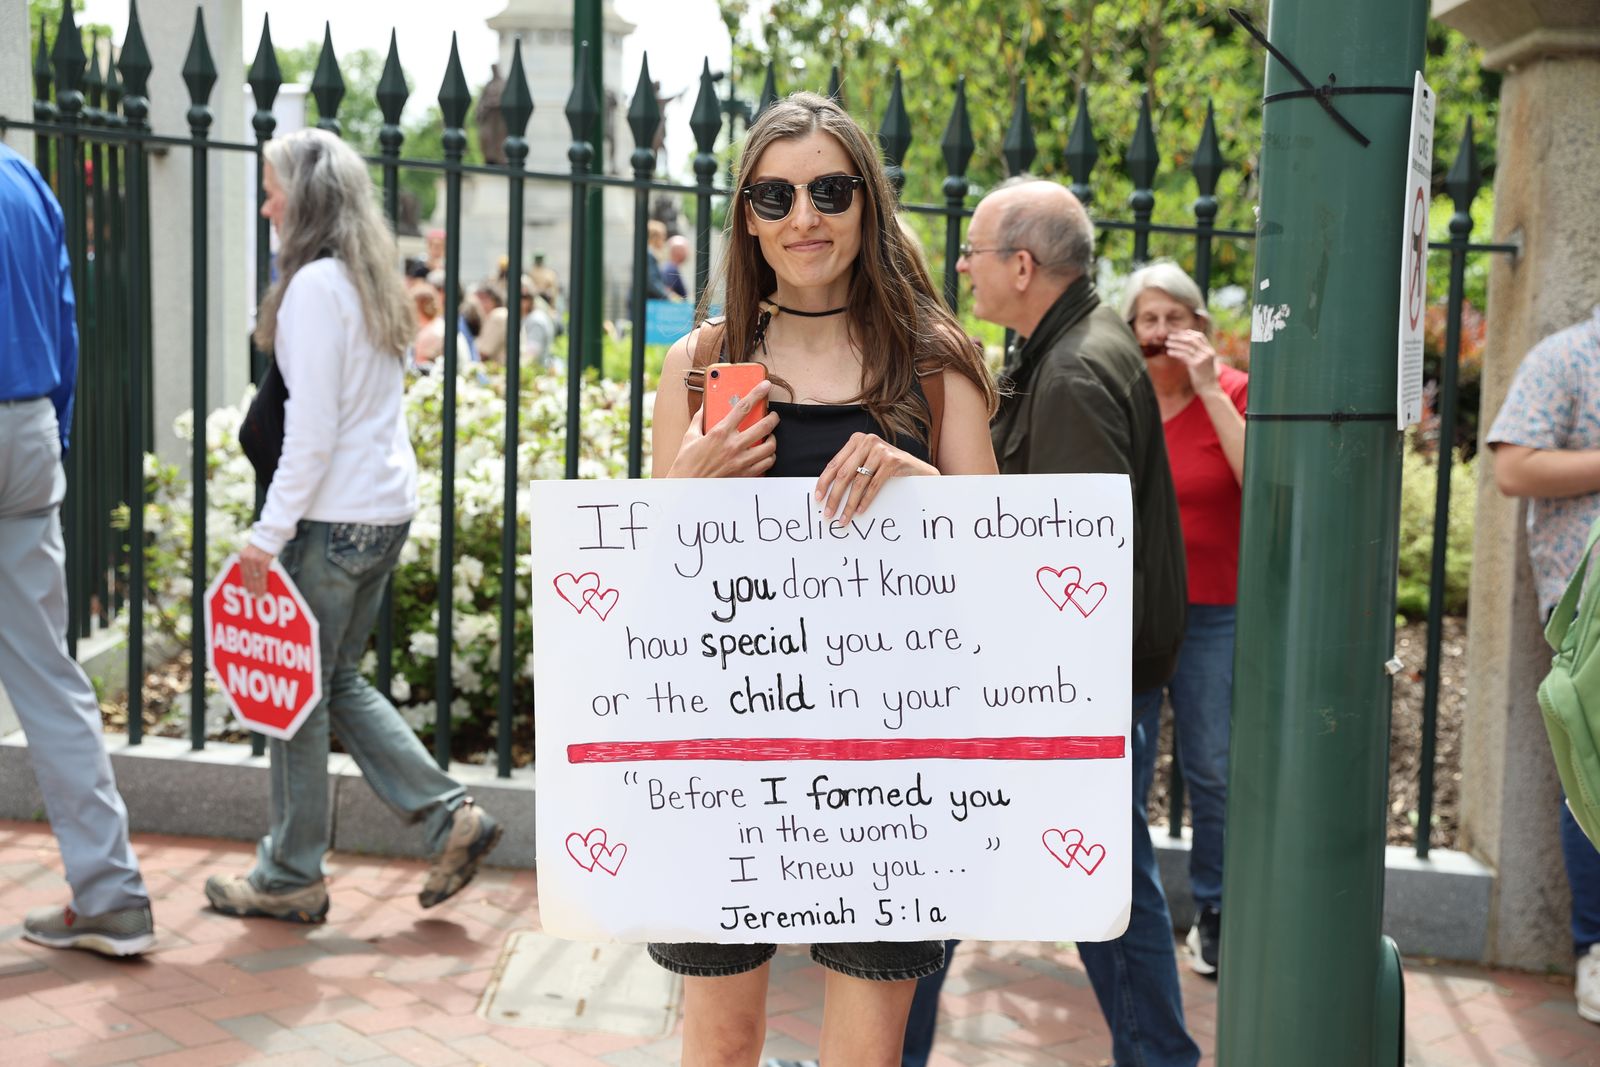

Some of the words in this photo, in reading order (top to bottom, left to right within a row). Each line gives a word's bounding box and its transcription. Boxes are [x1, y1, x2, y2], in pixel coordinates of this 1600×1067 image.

[577, 502, 649, 550] If
[674, 521, 746, 581] you
[755, 492, 901, 542] believe
[922, 509, 953, 539] in
[974, 496, 1124, 548] abortion,
[223, 583, 297, 627] STOP
[713, 577, 776, 623] you
[783, 557, 869, 599] don't
[880, 559, 955, 596] know
[214, 623, 312, 673] ABORTION
[626, 626, 687, 659] how
[701, 617, 807, 670] special
[827, 633, 892, 666] you
[906, 629, 980, 654] are,
[227, 662, 299, 711] NOW
[592, 693, 629, 716] or
[647, 682, 708, 712] the
[730, 673, 815, 714] child
[829, 683, 859, 708] in
[883, 686, 960, 730] your
[984, 665, 1091, 707] womb.
[760, 777, 787, 805] I
[806, 772, 932, 810] formed
[950, 789, 1010, 822] you
[738, 823, 763, 844] in
[776, 815, 828, 843] the
[840, 814, 927, 843] womb
[729, 856, 758, 882] I
[781, 855, 853, 880] knew
[873, 860, 965, 891] you...
[720, 897, 855, 930] Jeremiah
[875, 898, 946, 926] 5:1a
